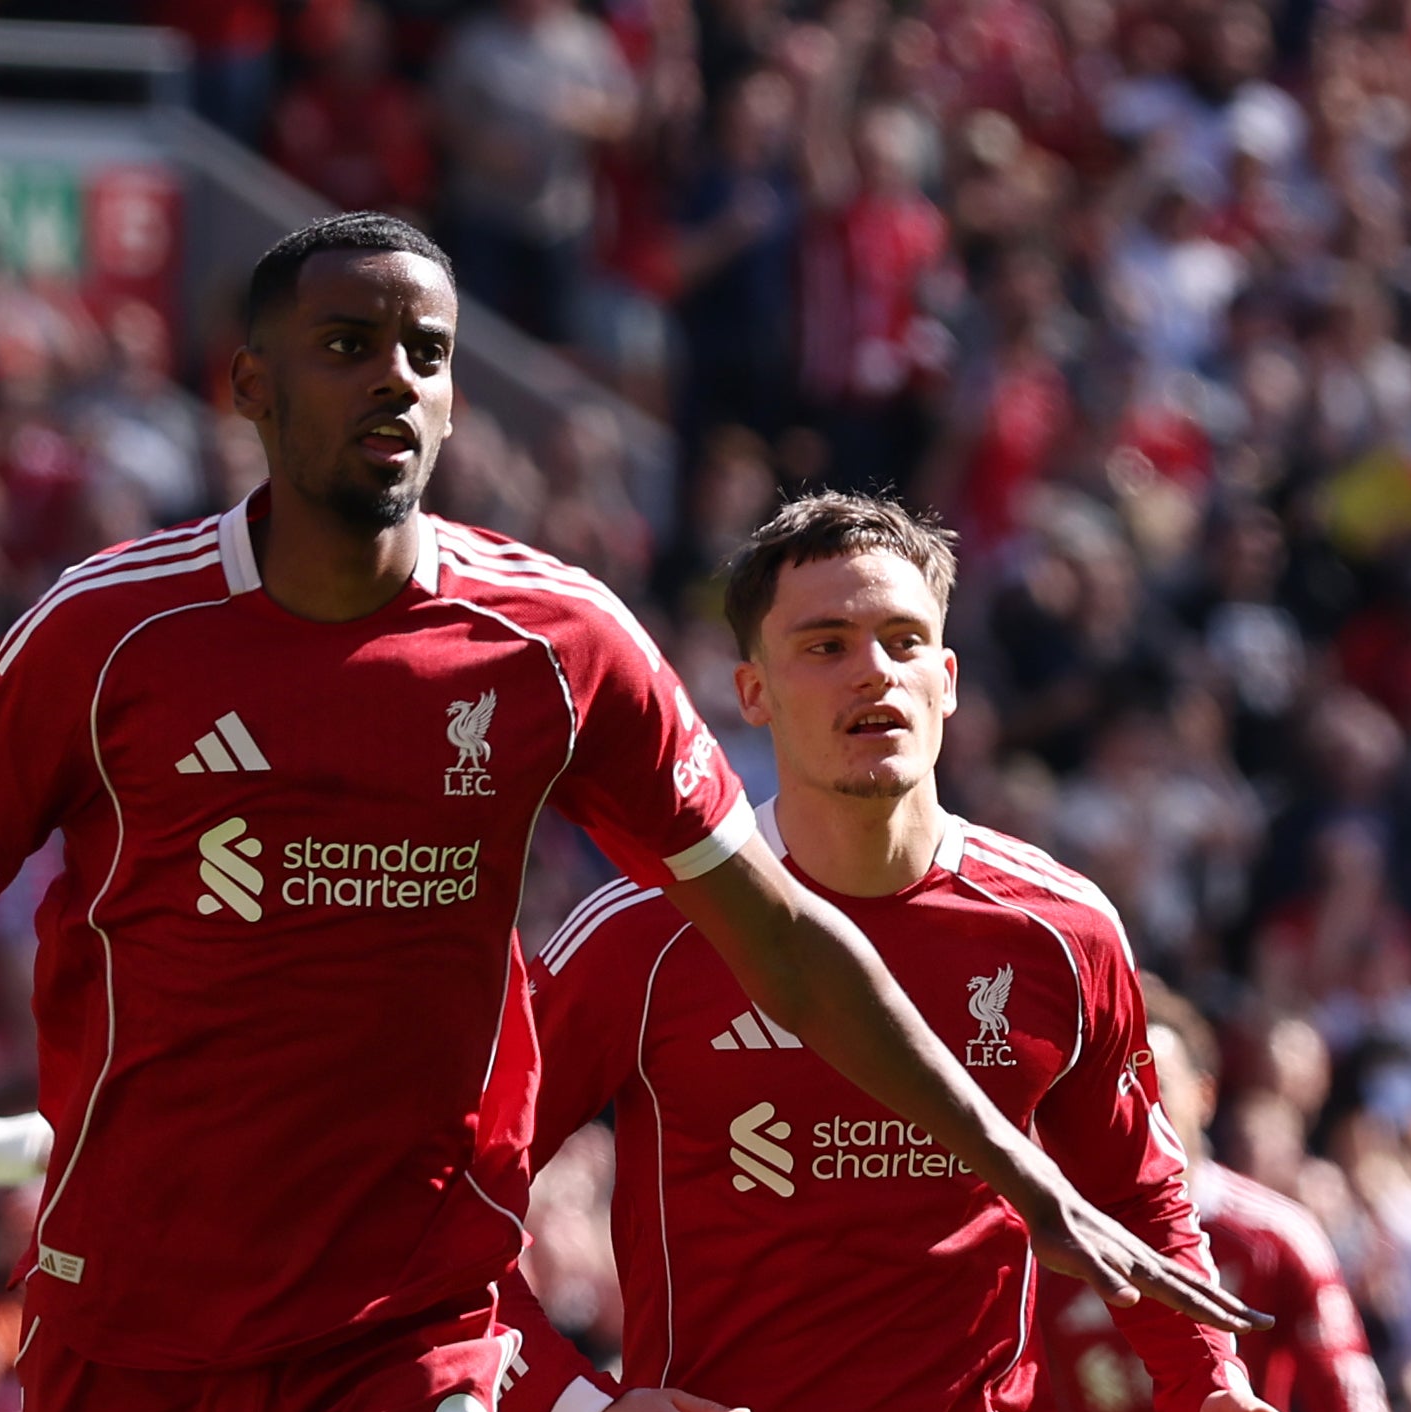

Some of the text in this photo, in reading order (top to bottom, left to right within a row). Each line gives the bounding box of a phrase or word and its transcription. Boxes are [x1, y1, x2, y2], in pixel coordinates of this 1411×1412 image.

[444, 774, 496, 796] L.F.C.
[283, 836, 480, 873] standard
[282, 867, 477, 908] chartered
[965, 1046, 1017, 1066] L.F.C.
